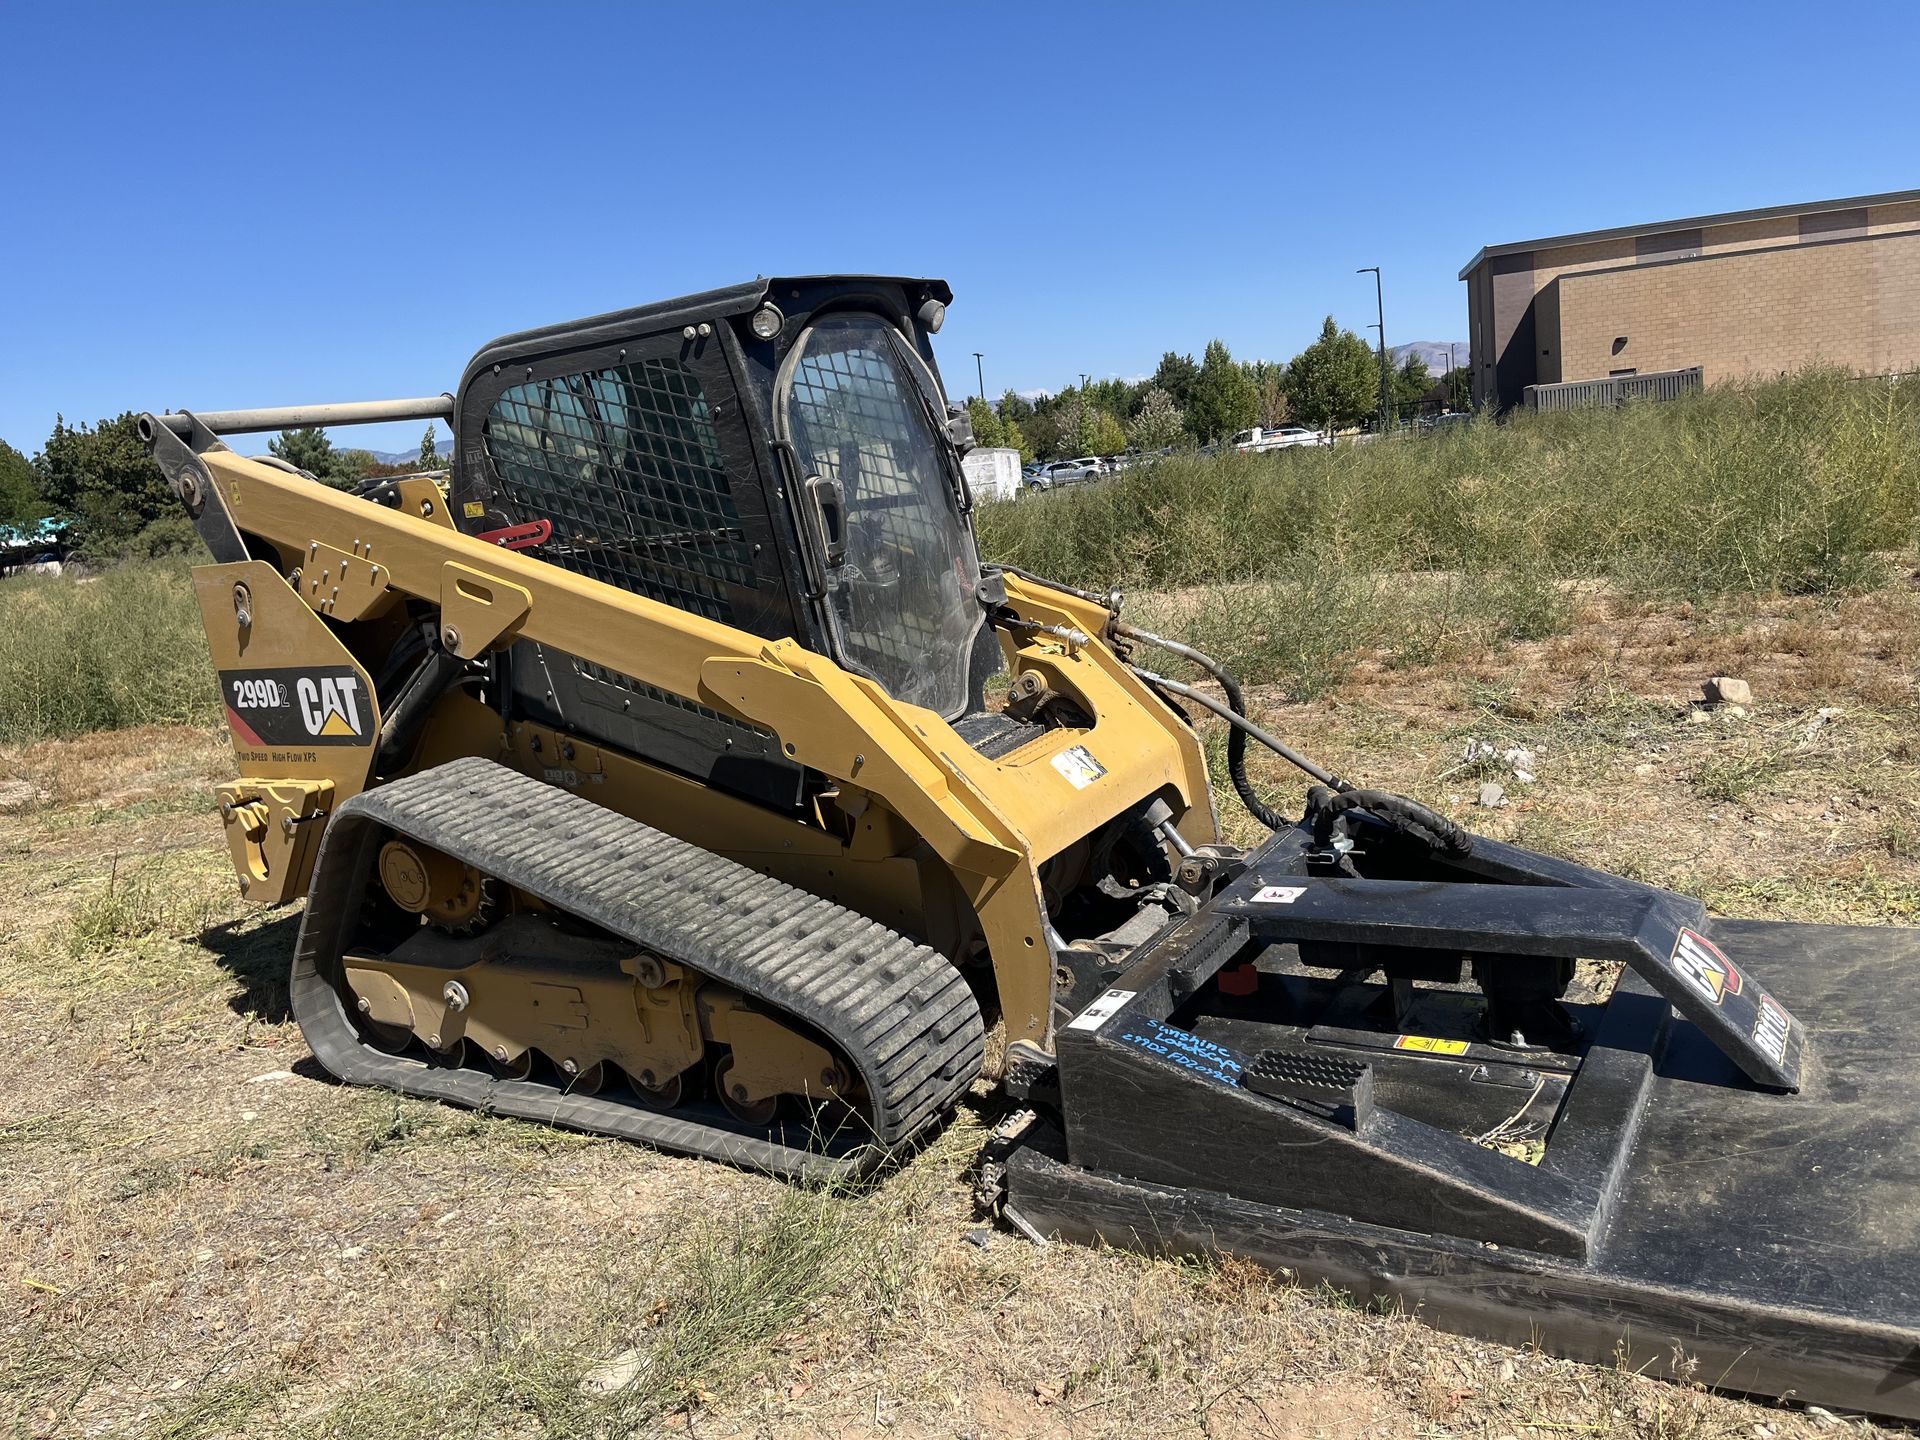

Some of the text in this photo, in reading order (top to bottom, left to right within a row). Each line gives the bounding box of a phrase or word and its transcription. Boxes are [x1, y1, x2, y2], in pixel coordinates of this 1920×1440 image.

[233, 679, 290, 708] 299D2
[296, 677, 362, 736] CAT
[303, 752, 317, 763] XPS
[1672, 932, 1726, 1002] CAT
[1146, 1018, 1231, 1057] Sunshine
[1754, 1001, 1787, 1064] BR118
